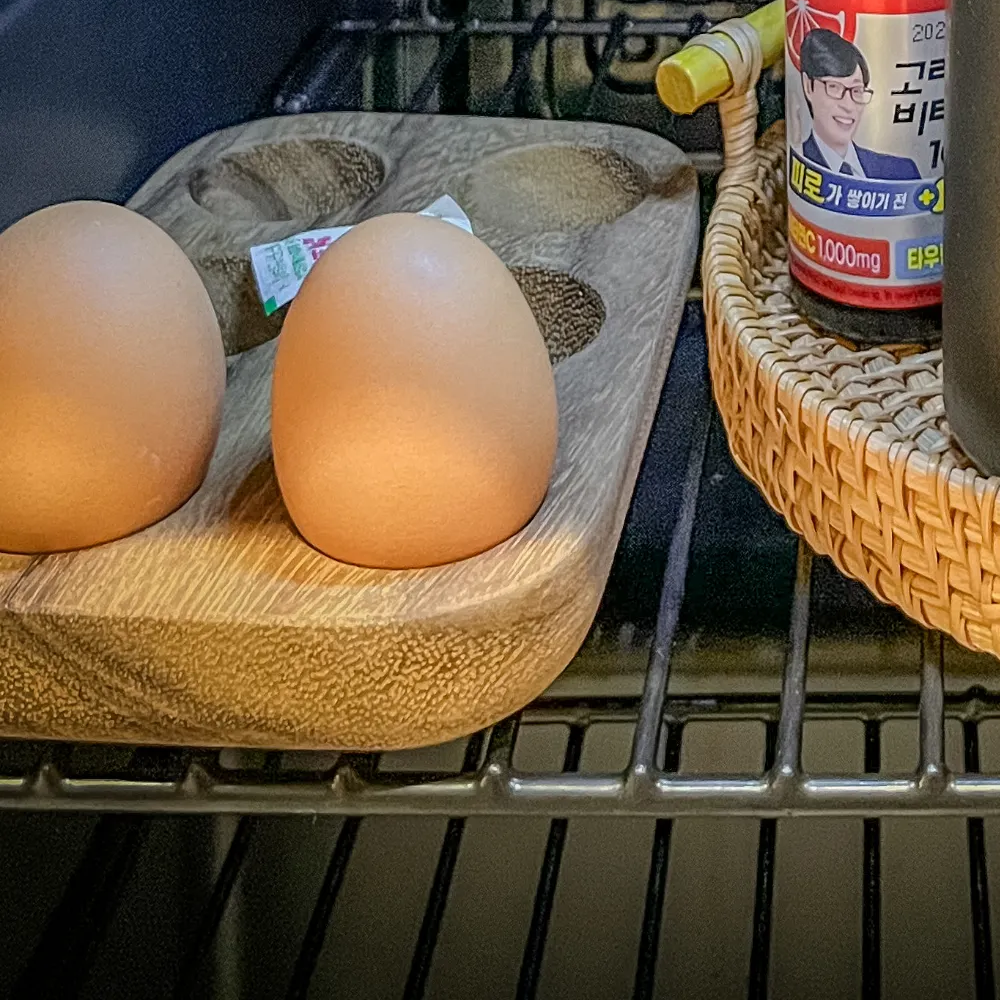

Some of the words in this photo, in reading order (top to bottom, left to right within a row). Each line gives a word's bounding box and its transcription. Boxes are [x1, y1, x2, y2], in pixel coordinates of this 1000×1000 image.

[929, 140, 944, 169] 1
[893, 191, 908, 210] 전
[907, 242, 944, 270] 타우
